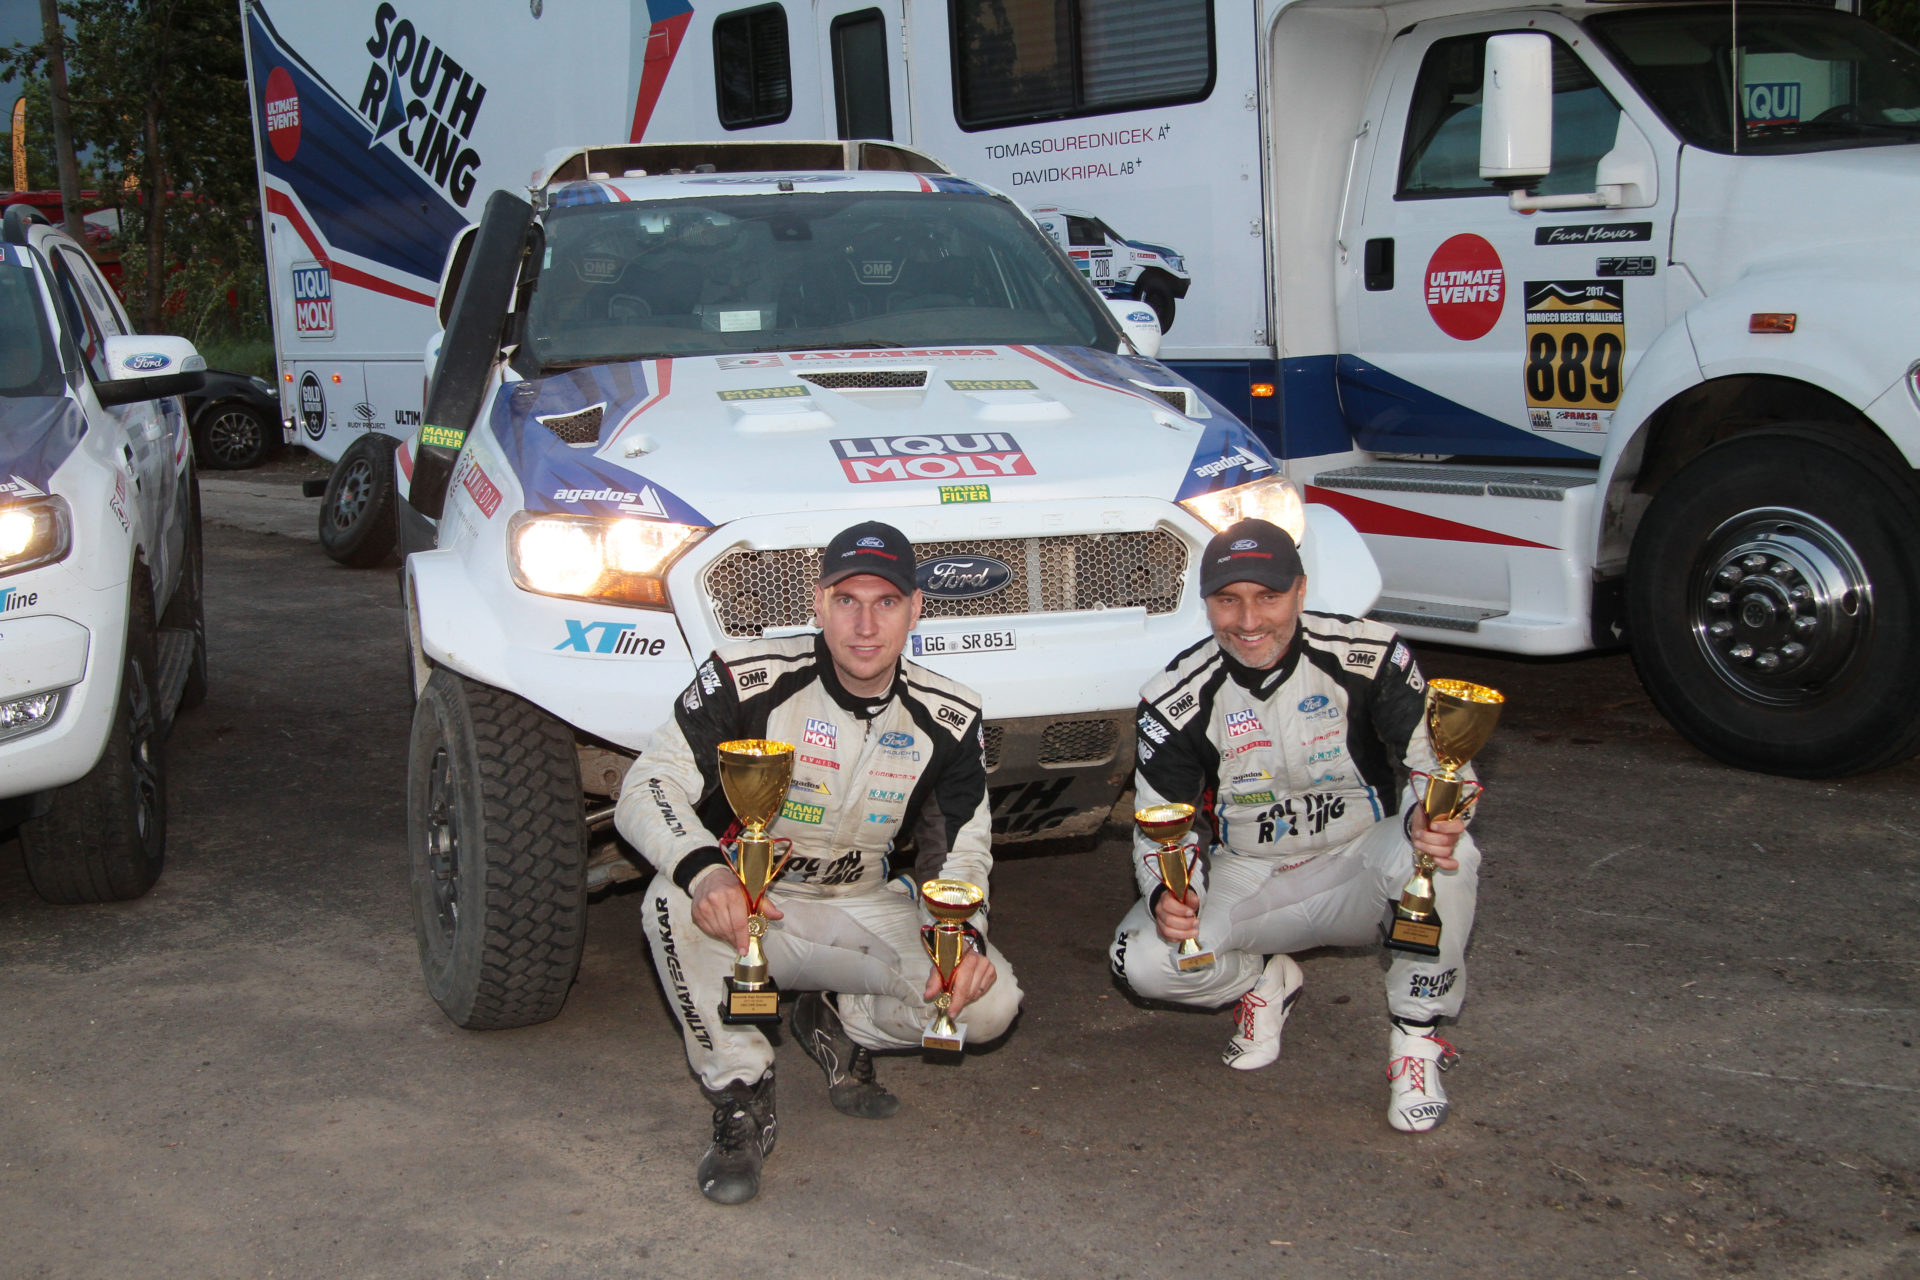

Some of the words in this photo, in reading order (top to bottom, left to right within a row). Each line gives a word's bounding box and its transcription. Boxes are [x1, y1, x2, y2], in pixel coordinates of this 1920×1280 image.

[366, 2, 487, 141] SOUTH
[267, 96, 299, 115] ULTIMATE
[1745, 86, 1798, 120] IQUI
[267, 111, 299, 131] EVENTS
[1548, 227, 1585, 242] Fun
[1585, 226, 1637, 241] Mover
[584, 261, 616, 275] OMP
[863, 262, 893, 276] OMP
[294, 270, 330, 298] LIQUI
[1430, 268, 1503, 287] ULTIMATE
[1427, 285, 1500, 305] EVENTS
[1586, 286, 1604, 297] 2017
[297, 301, 332, 329] MOLY
[1133, 313, 1151, 322] Ford
[1526, 313, 1559, 323] MOROCCO
[1560, 313, 1584, 323] DESERT
[1585, 312, 1622, 323] CHALLENGE
[133, 355, 164, 369] Ford
[1526, 332, 1623, 404] 889
[421, 435, 463, 449] FILTER
[423, 426, 464, 440] MANN
[838, 433, 1012, 457] LIQUI
[850, 453, 1022, 481] MOLY
[1193, 454, 1248, 477] agados
[553, 486, 638, 504] agados
[940, 484, 988, 493] MANN
[942, 492, 989, 503] FILTER
[927, 561, 990, 589] Ford
[553, 619, 666, 657] XTline
[924, 636, 946, 652] GG
[962, 633, 982, 649] SR
[984, 631, 1014, 648] 851
[1347, 653, 1376, 665] OMP
[739, 670, 768, 687] OMP
[1169, 694, 1194, 717] OMP
[938, 707, 966, 726] OMP
[1226, 709, 1256, 724] LIQU
[1230, 719, 1261, 737] MOLY
[883, 733, 908, 745] Ford
[790, 778, 820, 791] gados
[781, 809, 821, 824] FILTER
[784, 801, 823, 815] MANN
[1410, 968, 1458, 987] SOUTH
